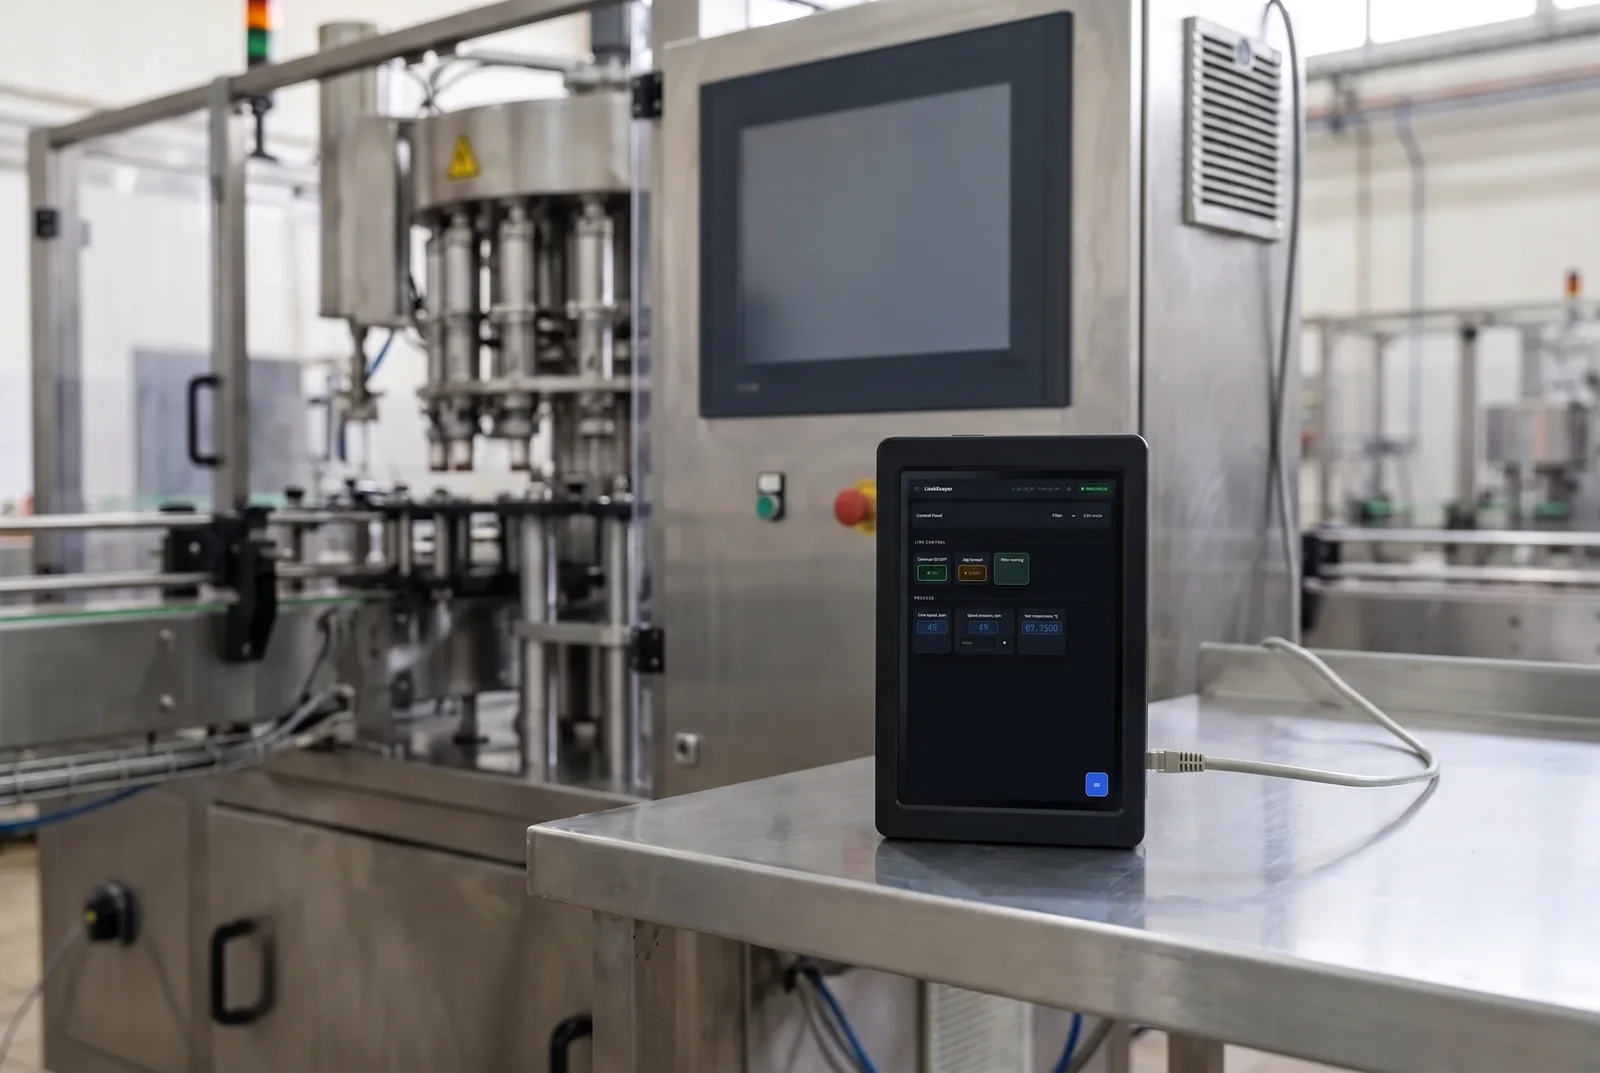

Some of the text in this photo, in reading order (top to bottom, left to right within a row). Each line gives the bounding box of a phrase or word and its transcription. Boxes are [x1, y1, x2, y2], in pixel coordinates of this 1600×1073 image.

[927, 623, 938, 631] 49
[978, 623, 989, 632] 49
[1025, 624, 1058, 632] 87.7500
